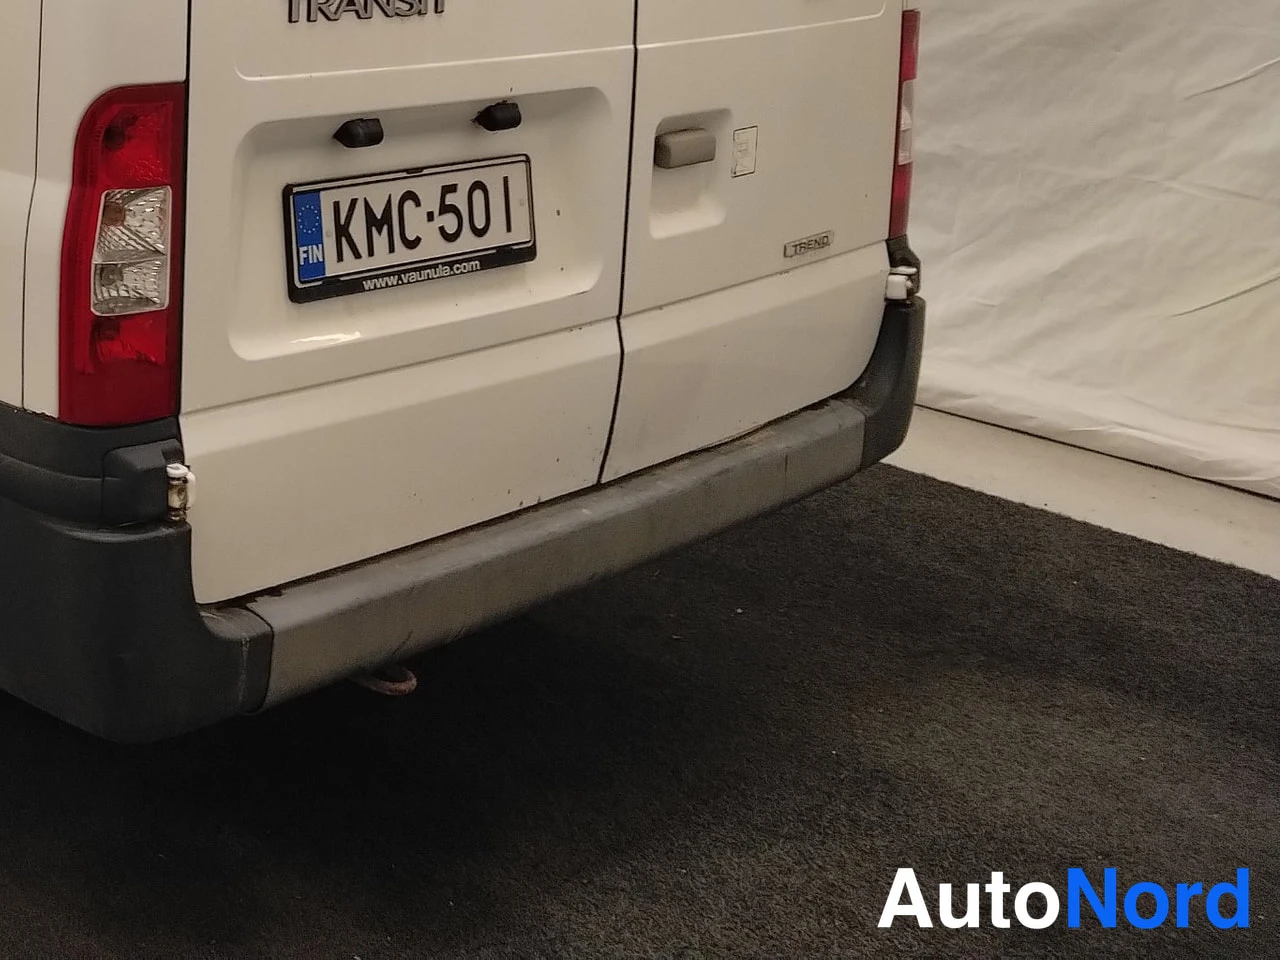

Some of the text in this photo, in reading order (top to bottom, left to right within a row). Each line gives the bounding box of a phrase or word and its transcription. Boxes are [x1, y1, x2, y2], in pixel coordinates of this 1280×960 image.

[299, 243, 324, 265] FIN
[791, 234, 829, 254] TREND
[363, 259, 481, 291] www.vaunula.com
